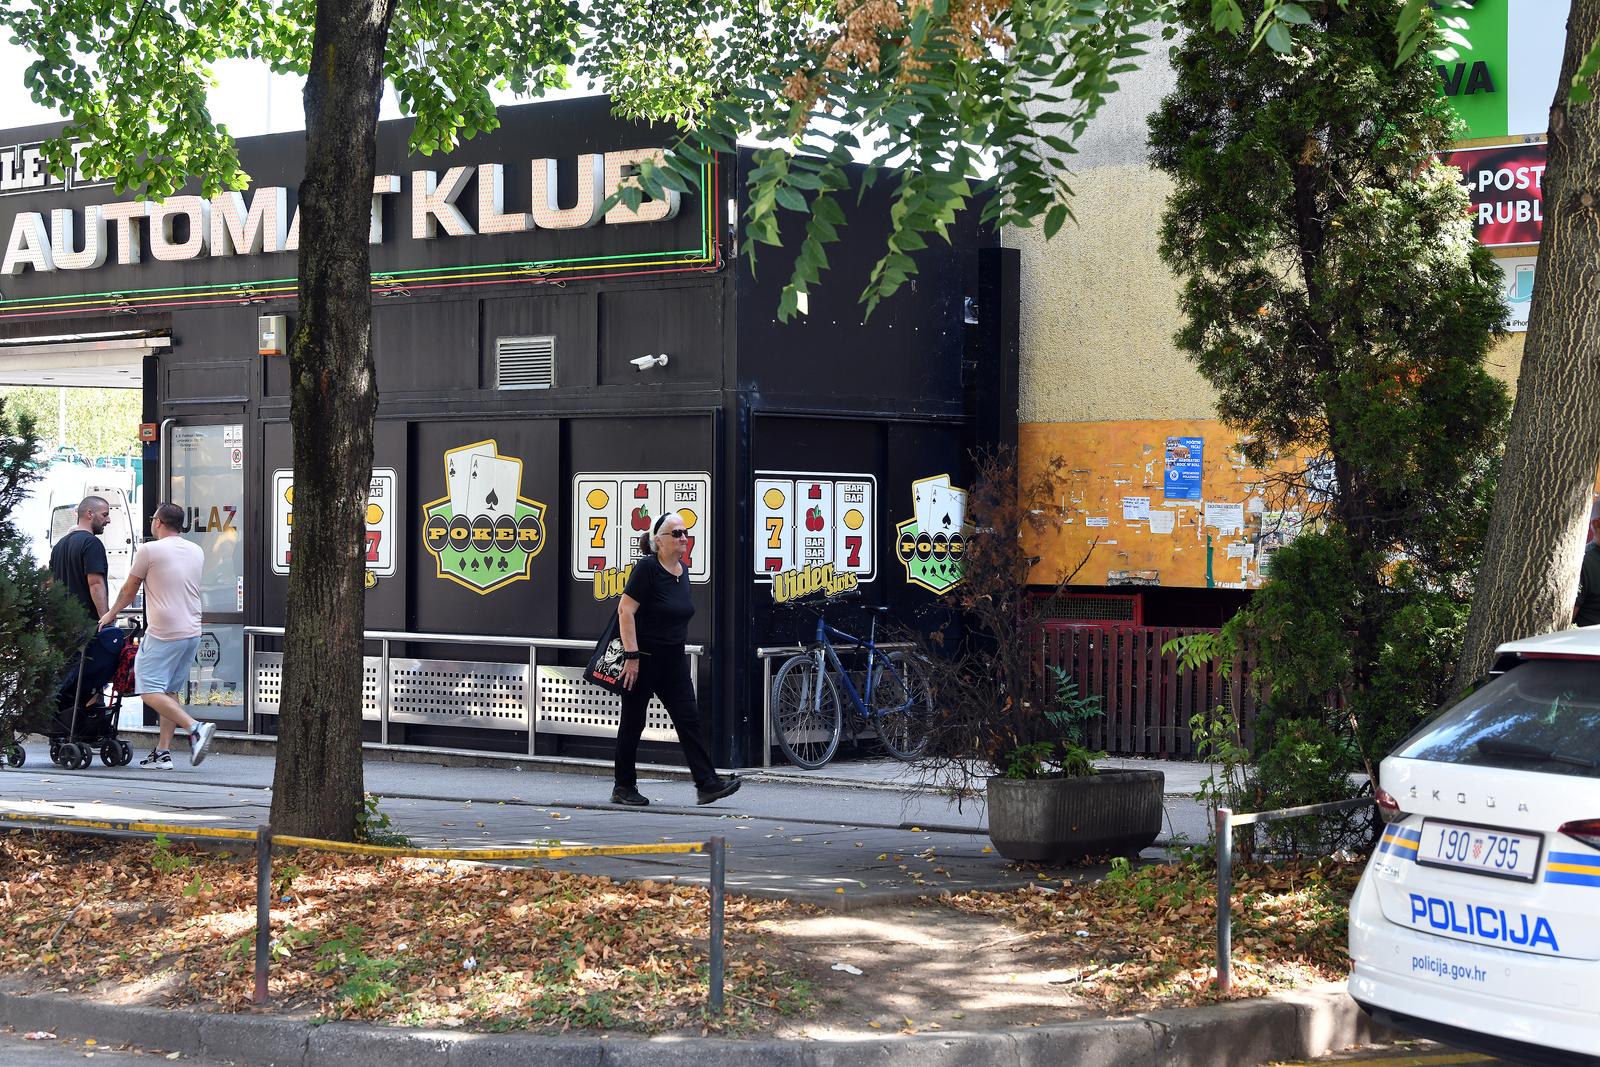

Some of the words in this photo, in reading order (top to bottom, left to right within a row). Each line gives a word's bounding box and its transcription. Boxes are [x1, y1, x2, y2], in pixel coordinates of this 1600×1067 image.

[1479, 166, 1545, 192] POST
[412, 148, 681, 239] KLUB
[1479, 200, 1543, 225] RUBL
[368, 488, 383, 497] AR
[675, 492, 696, 501] BAR
[844, 493, 863, 502] BAR
[428, 527, 540, 541] POKER
[589, 517, 607, 548] 7
[766, 517, 783, 549] 7
[805, 537, 824, 547] BAR
[805, 548, 824, 557] BAR
[845, 536, 862, 567] 7
[901, 542, 964, 553] POKE
[594, 563, 633, 600] Vid
[1437, 829, 1470, 861] 190
[1483, 836, 1520, 869] 795
[1409, 893, 1560, 952] POLICIJA
[1412, 955, 1486, 982] policija.gov.hr
